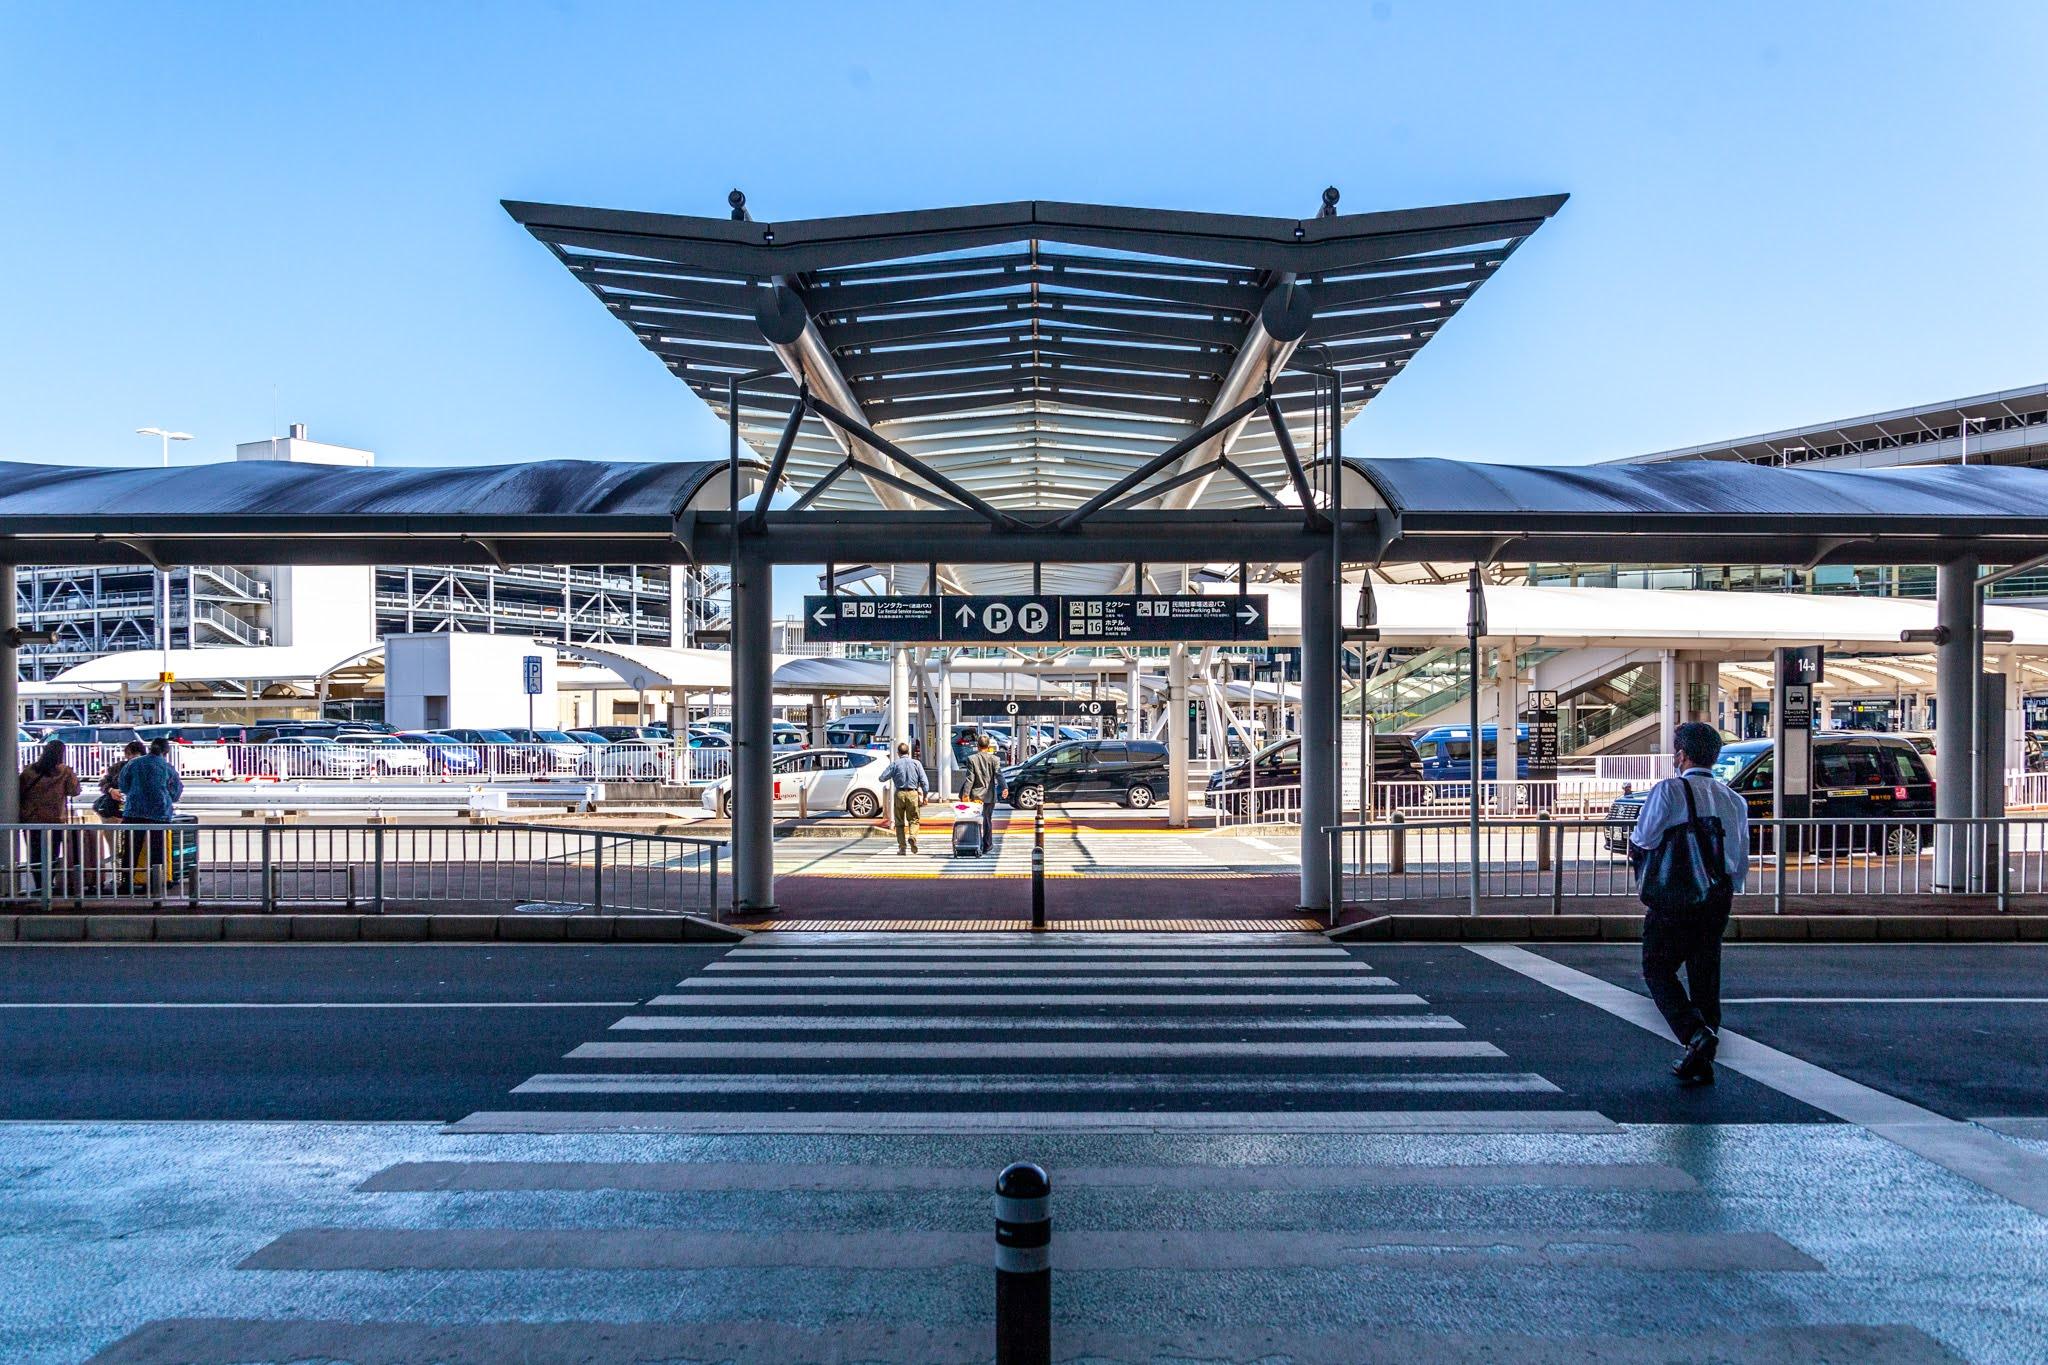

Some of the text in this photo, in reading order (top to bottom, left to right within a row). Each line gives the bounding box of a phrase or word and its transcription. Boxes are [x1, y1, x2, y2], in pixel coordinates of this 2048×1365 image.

[861, 605, 874, 615] 20
[1089, 604, 1101, 614] 15
[1156, 604, 1168, 614] 17
[1190, 607, 1211, 615] Parking
[990, 608, 1008, 629] P1
[1026, 608, 1043, 629] P5
[1089, 622, 1101, 632] 16
[531, 664, 539, 676] P
[1798, 658, 1816, 672] 14-a
[166, 673, 172, 681] A
